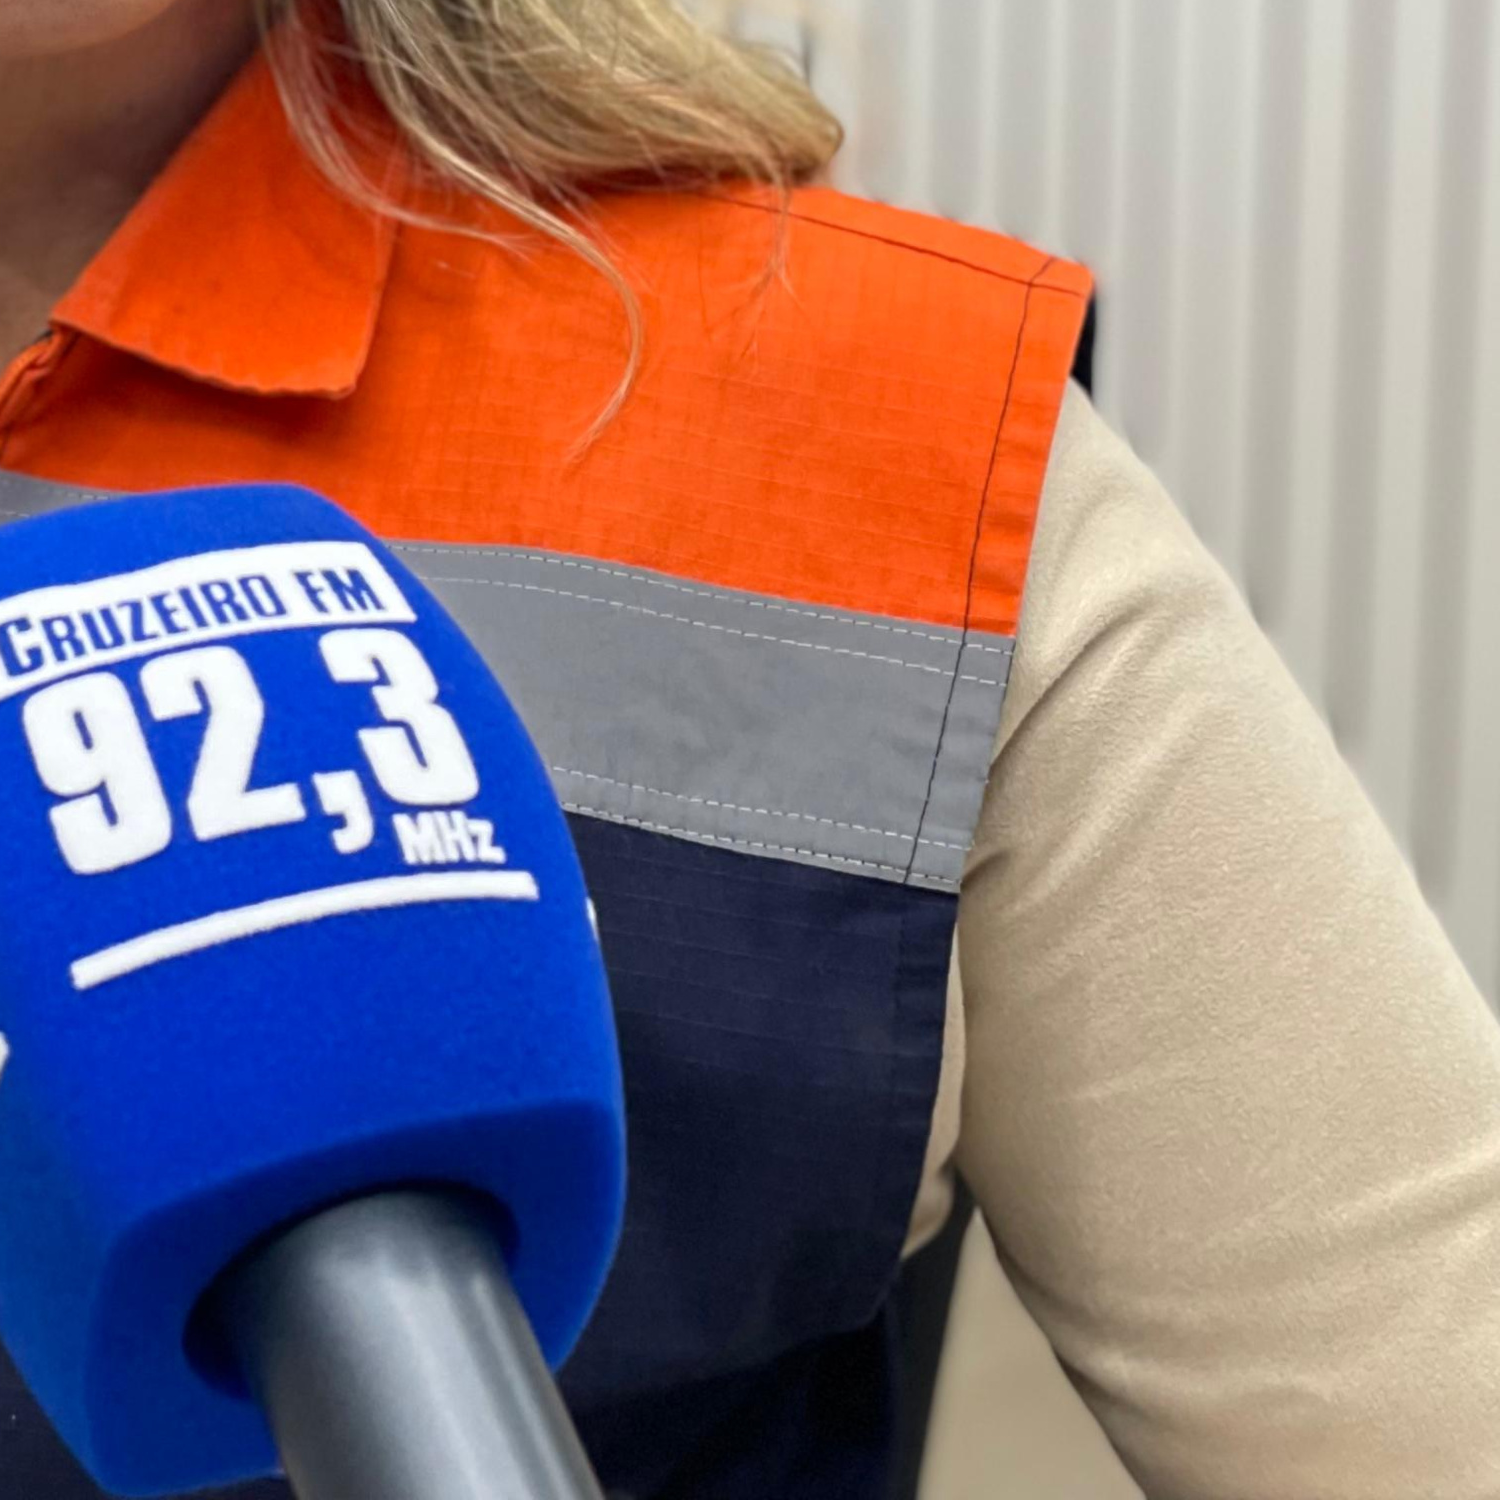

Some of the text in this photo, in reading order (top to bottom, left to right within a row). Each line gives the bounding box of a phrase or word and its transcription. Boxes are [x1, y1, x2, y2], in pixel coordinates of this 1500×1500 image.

[293, 566, 386, 615] FM
[22, 628, 479, 875] 92,3
[392, 809, 507, 865] MHz
